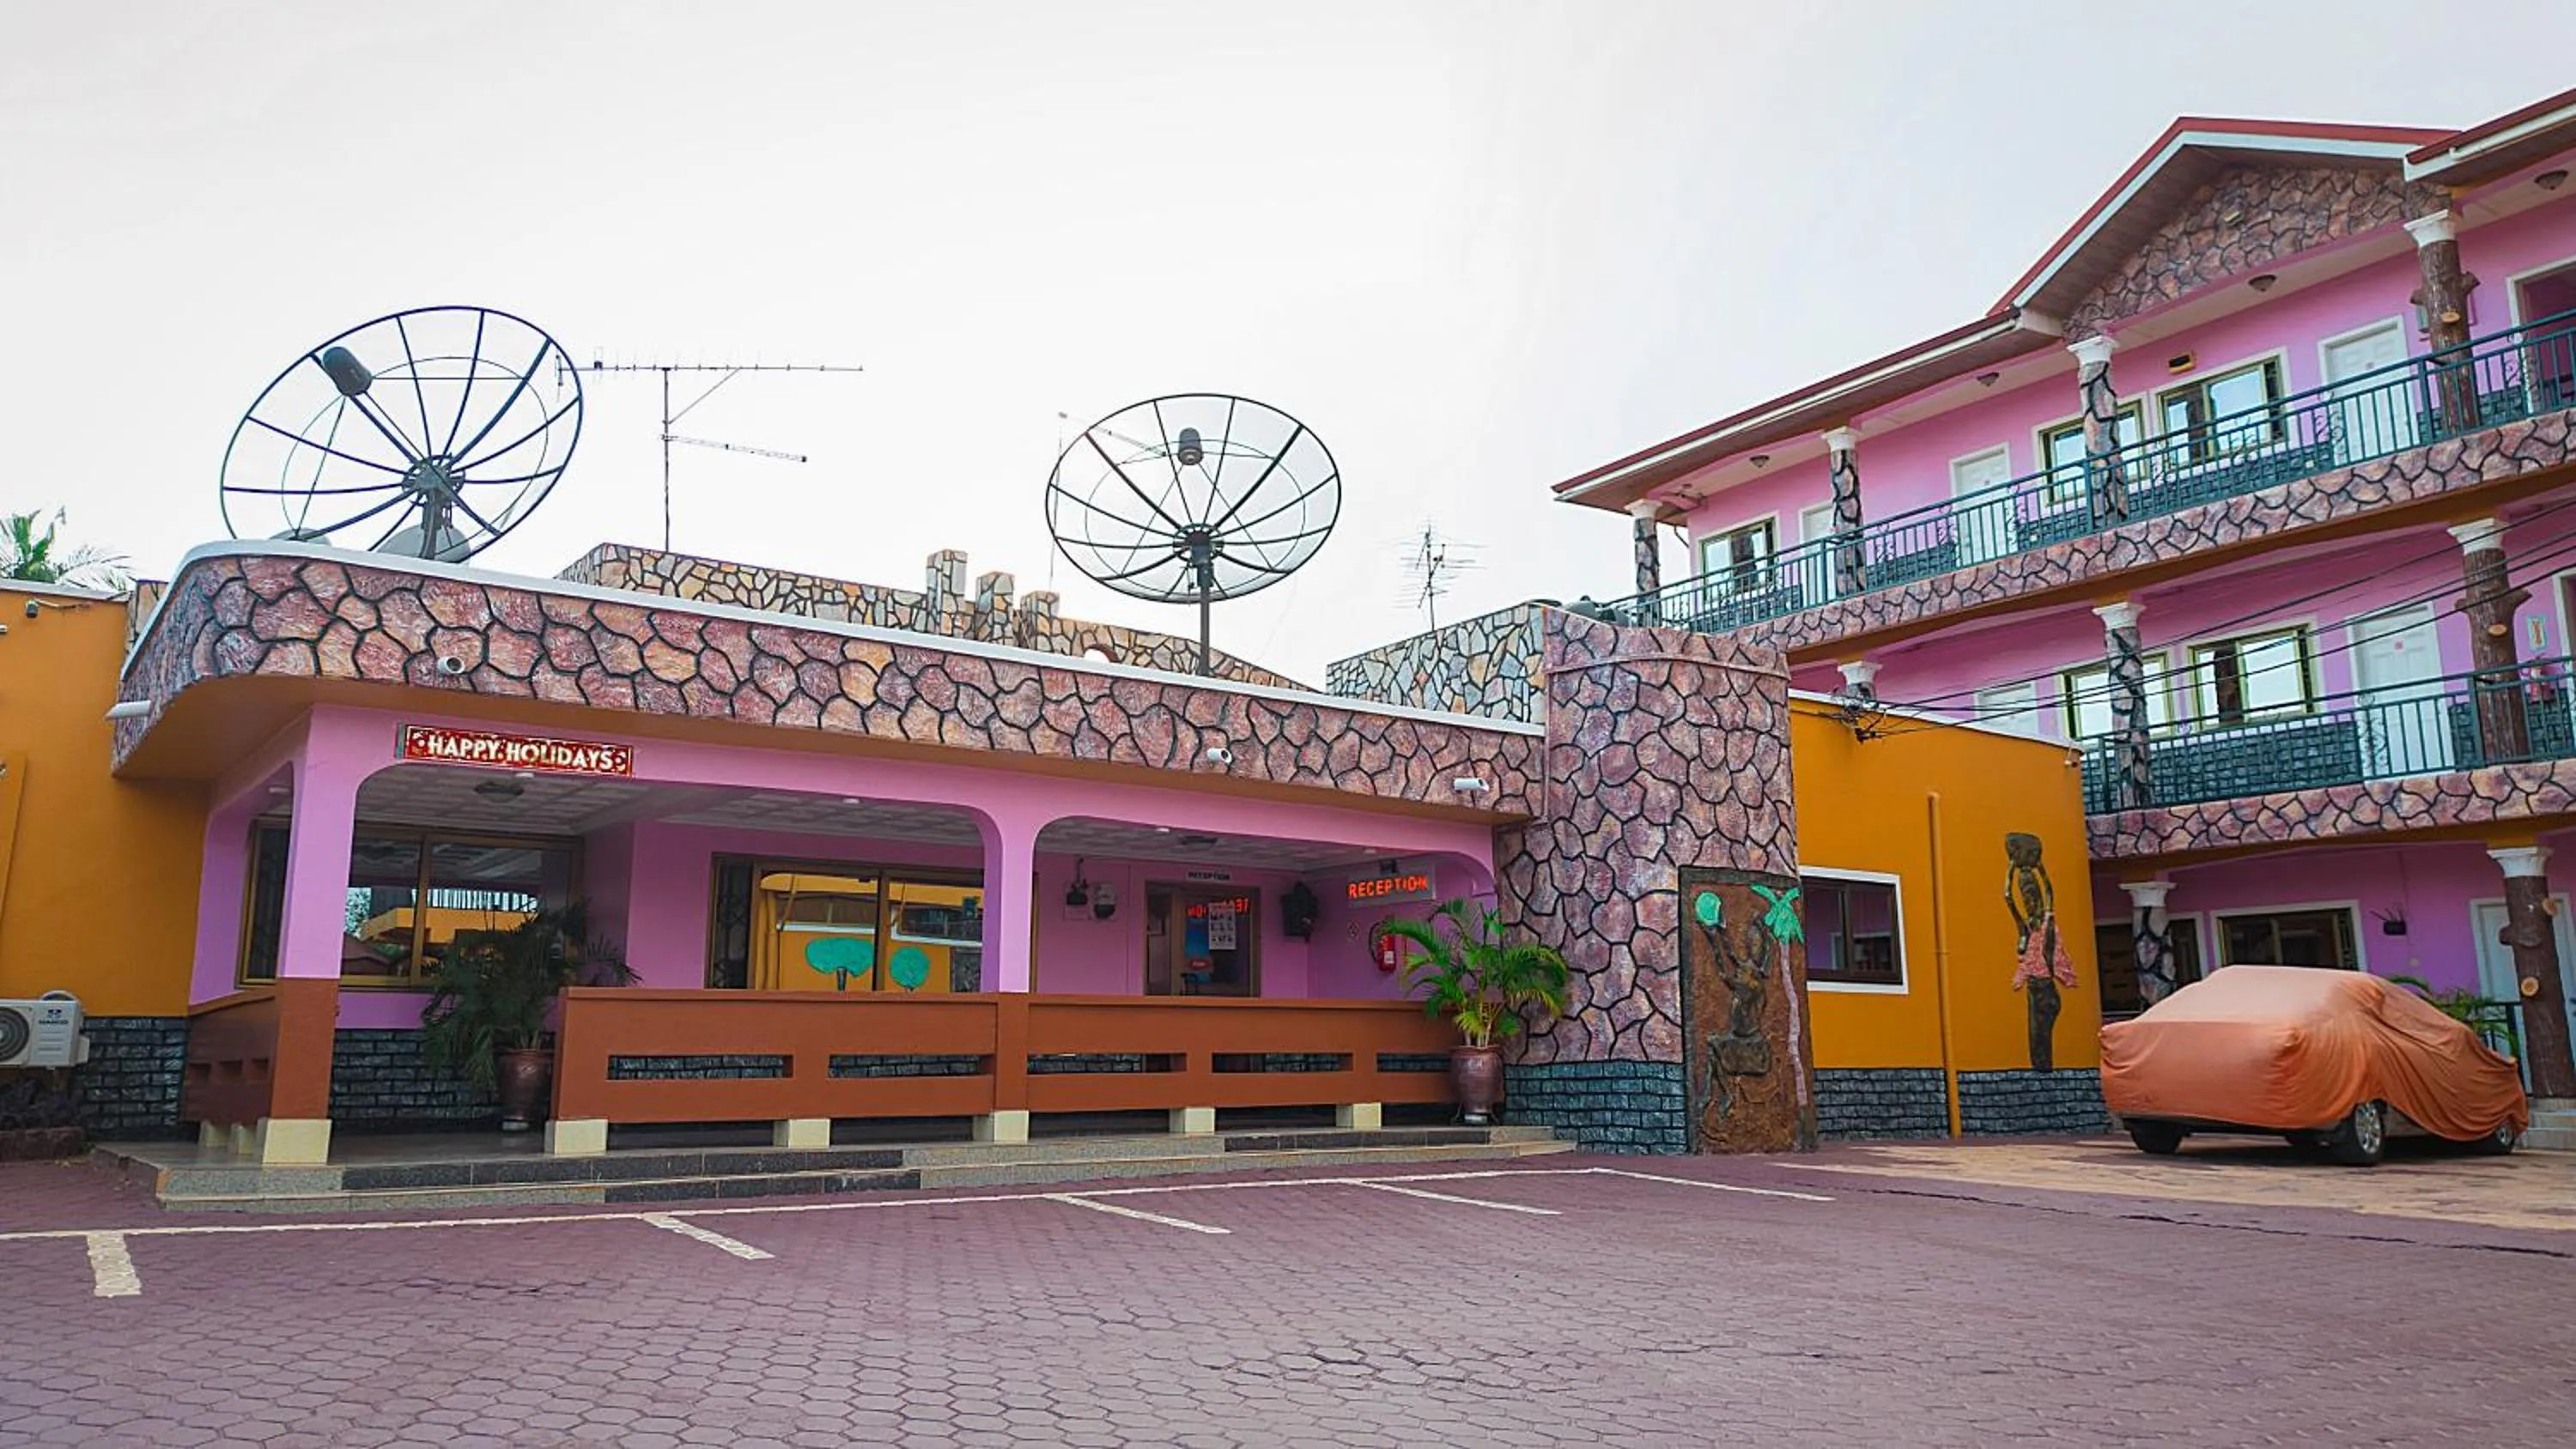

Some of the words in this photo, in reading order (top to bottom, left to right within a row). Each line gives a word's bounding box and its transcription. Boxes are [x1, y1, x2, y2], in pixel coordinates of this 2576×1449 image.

[428, 733, 498, 760] HAPPY
[506, 743, 612, 770] HOLIDAYS
[1348, 876, 1428, 900] RECEPTION
